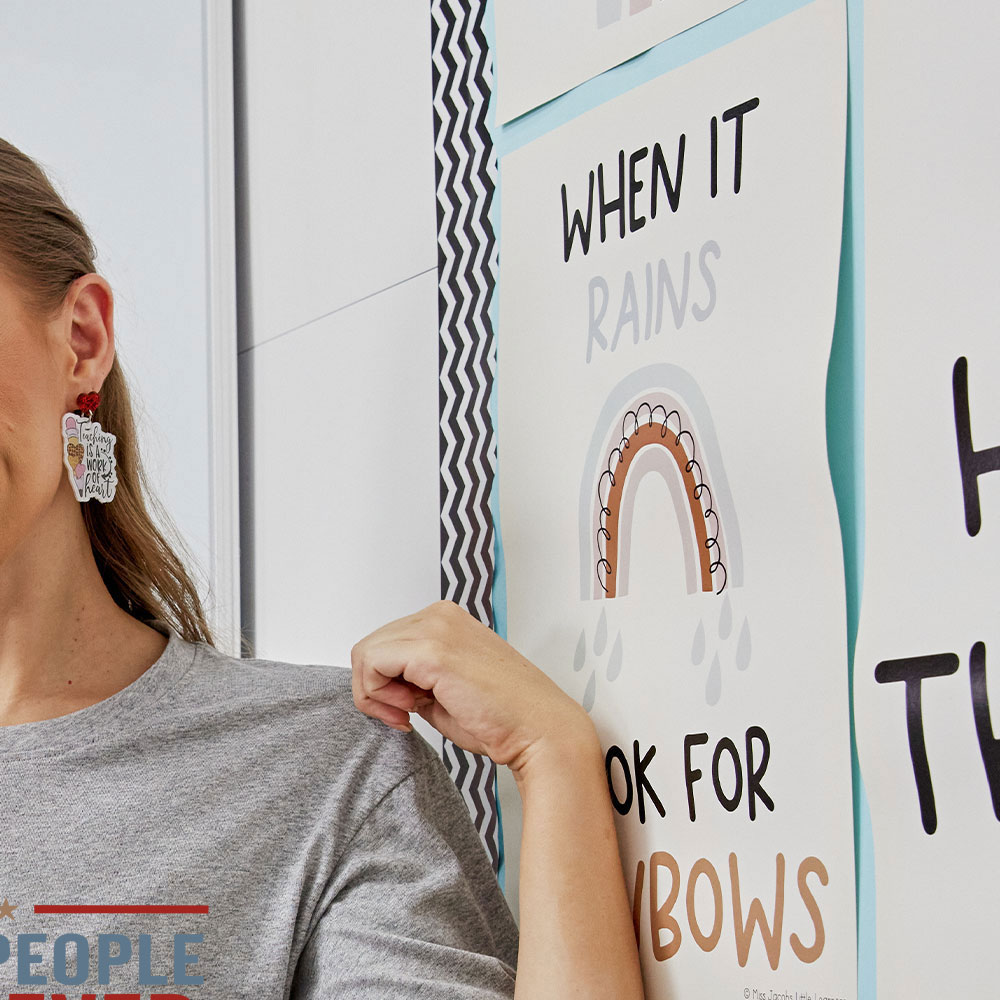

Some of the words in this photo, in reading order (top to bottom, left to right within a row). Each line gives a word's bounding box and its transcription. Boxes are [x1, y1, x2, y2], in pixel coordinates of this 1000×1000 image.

[561, 134, 686, 263] WHEN
[710, 97, 760, 198] IT
[585, 240, 721, 364] RAINS
[76, 418, 113, 454] Teaching
[86, 459, 107, 472] WORK
[84, 474, 114, 498] heart
[605, 739, 666, 824] OK
[683, 725, 775, 822] FOR
[634, 851, 829, 970] BOWS
[752, 988, 766, 1000] Miss
